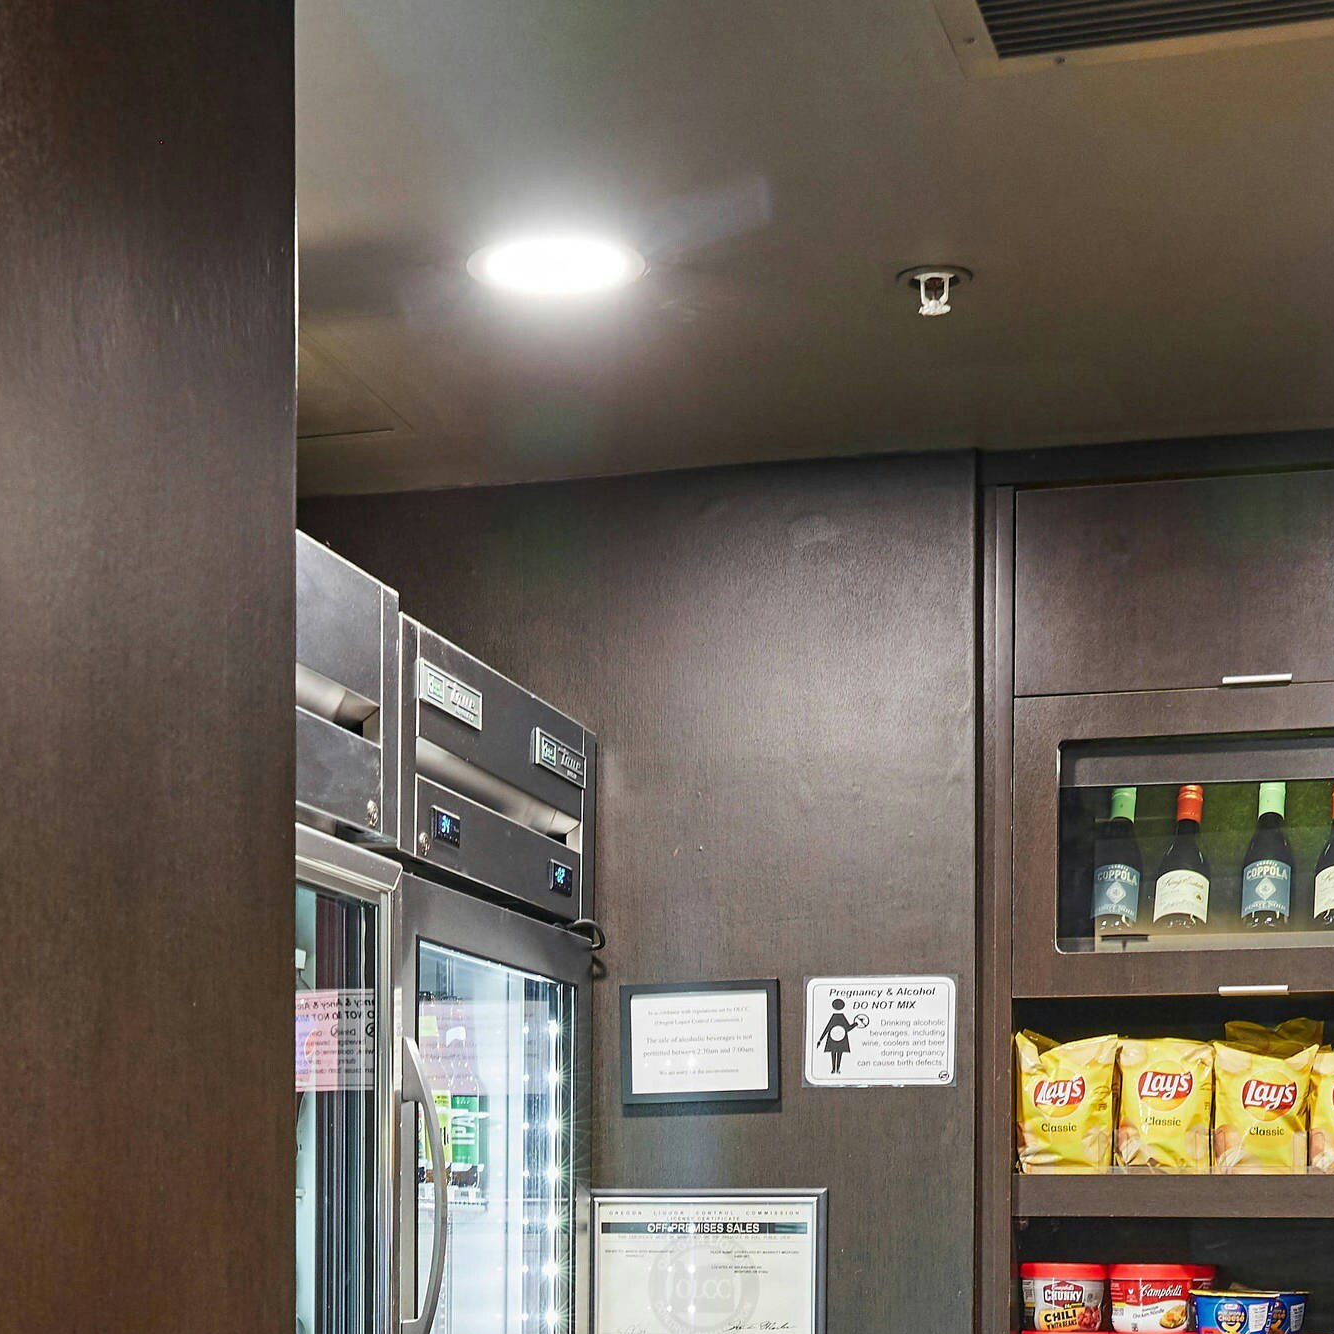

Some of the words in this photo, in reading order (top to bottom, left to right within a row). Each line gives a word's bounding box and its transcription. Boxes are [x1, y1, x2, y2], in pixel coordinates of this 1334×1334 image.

[1097, 869, 1137, 886] COPPOLA
[1247, 866, 1288, 880] COPPOLA
[829, 987, 883, 998] Pregnancy
[886, 987, 893, 996] &
[896, 986, 936, 996] Alcohol
[852, 1001, 868, 1010] DO
[871, 1001, 894, 1010] NOT
[896, 1000, 917, 1010] MIX
[880, 1019, 911, 1028] Drinking
[913, 1018, 945, 1026] alcoholic
[912, 1028, 945, 1038] including
[883, 1039, 910, 1047] coolers
[928, 1039, 945, 1047] beer
[880, 1049, 904, 1057] during
[906, 1049, 945, 1057] pregnancy
[897, 1059, 914, 1067] birth
[1036, 1075, 1085, 1105] Lay's
[1139, 1071, 1192, 1100] Lay's
[1243, 1079, 1297, 1111] Lay's
[451, 1109, 476, 1145] IPA
[1040, 1121, 1078, 1133] Classic
[1143, 1116, 1182, 1128] Classic
[1248, 1125, 1286, 1137] Classic
[726, 1223, 760, 1233] SALES
[1044, 1290, 1083, 1302] CHUNKY
[1141, 1283, 1184, 1299] Campbell's
[1043, 1309, 1077, 1323] CHILI
